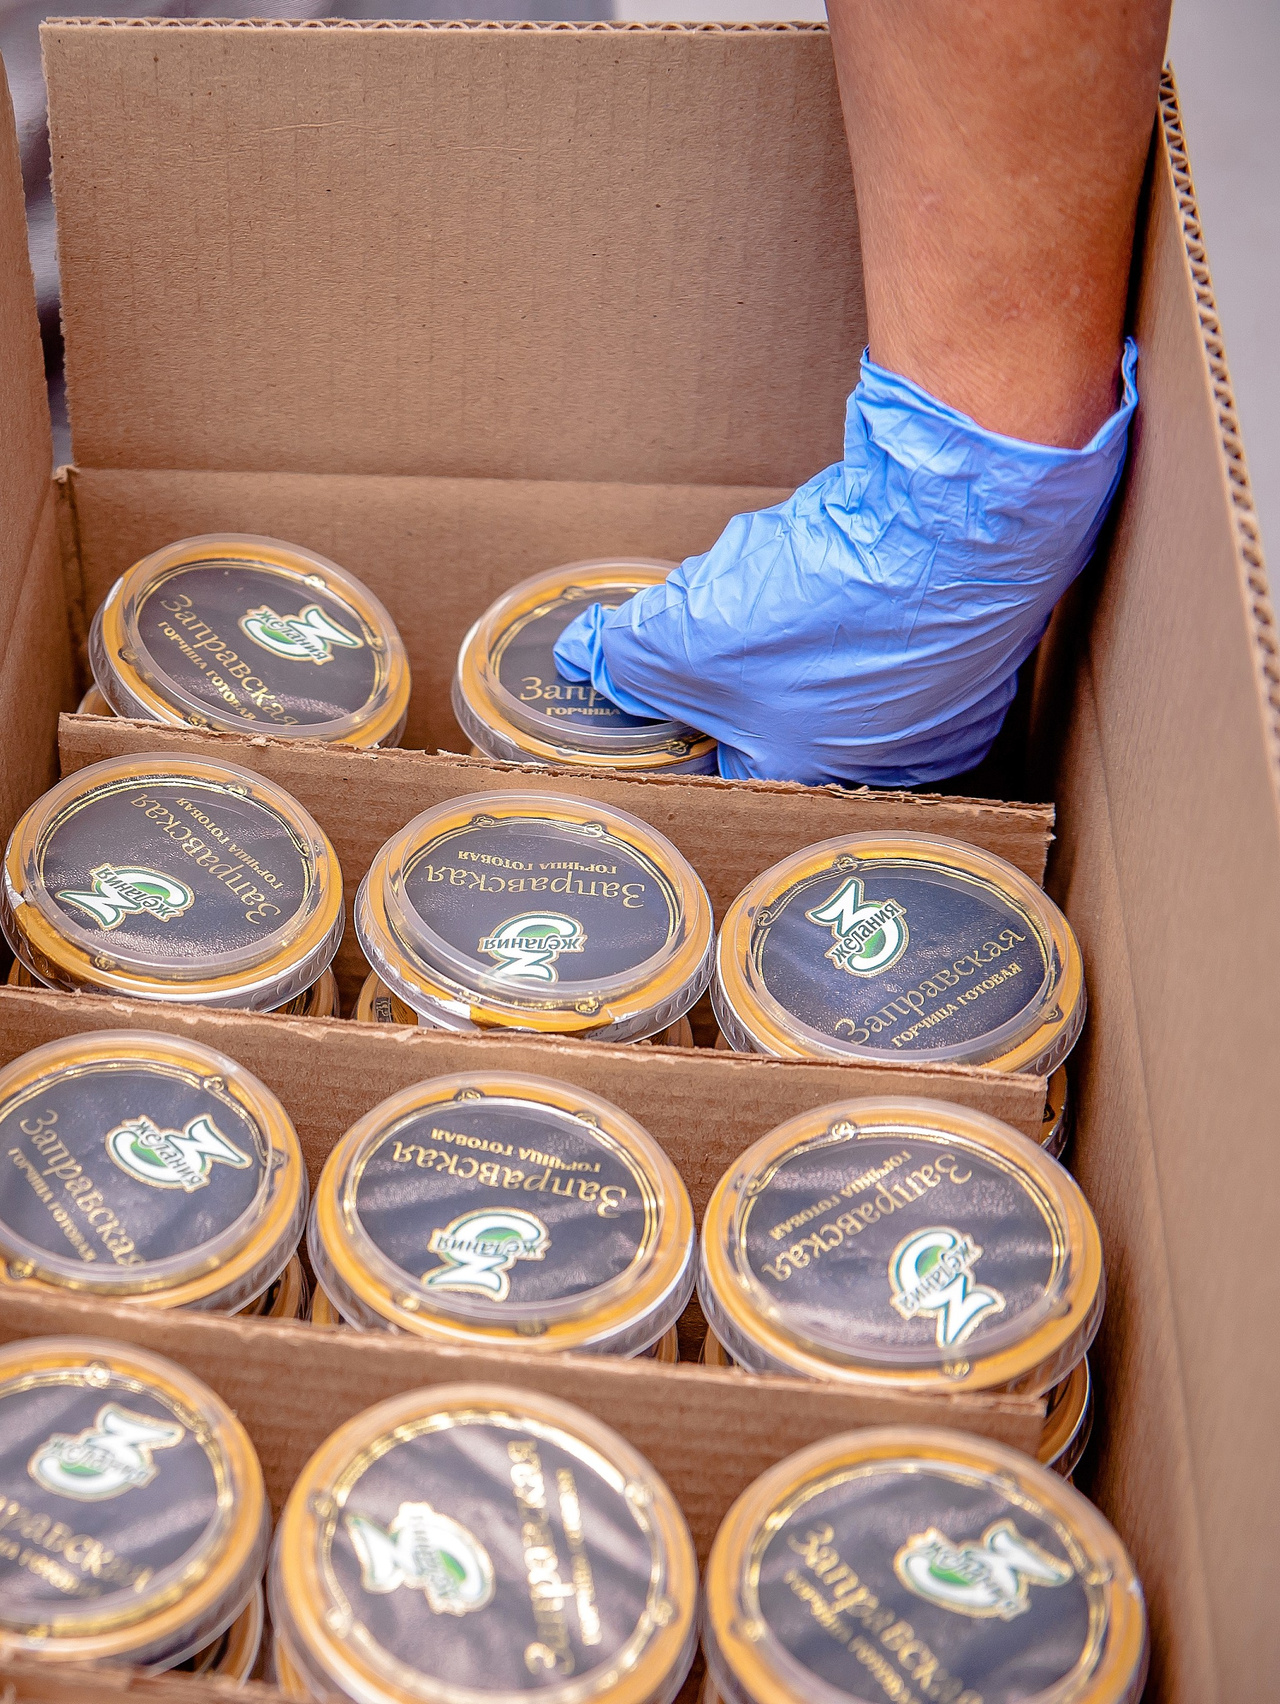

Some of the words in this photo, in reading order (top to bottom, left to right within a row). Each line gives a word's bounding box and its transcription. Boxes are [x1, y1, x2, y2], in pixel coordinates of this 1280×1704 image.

[160, 593, 300, 726] Заправская
[255, 609, 330, 661] желания
[157, 620, 208, 671] ГОРЧИЦА
[206, 669, 256, 722] ГОТОВАЯ
[175, 797, 231, 844] ГОТОВАЯ
[130, 793, 281, 925] Заправская
[228, 845, 285, 890] ГОРЧИЦА
[425, 863, 646, 909] Заправская
[458, 850, 533, 870] ГОТОВАЯ
[540, 862, 617, 874] ГОРЧИЦА
[96, 868, 176, 918] желания
[483, 936, 581, 951] желания
[832, 900, 902, 964] желания
[834, 927, 1026, 1047] Заправская
[891, 1003, 958, 1049] ГОРЧИЦА
[957, 961, 1022, 1006] ГОТОВАЯ
[131, 1120, 204, 1188] желания
[393, 1141, 627, 1219] Заправская
[20, 1109, 146, 1267] Заправская
[762, 1153, 972, 1283] Заправская
